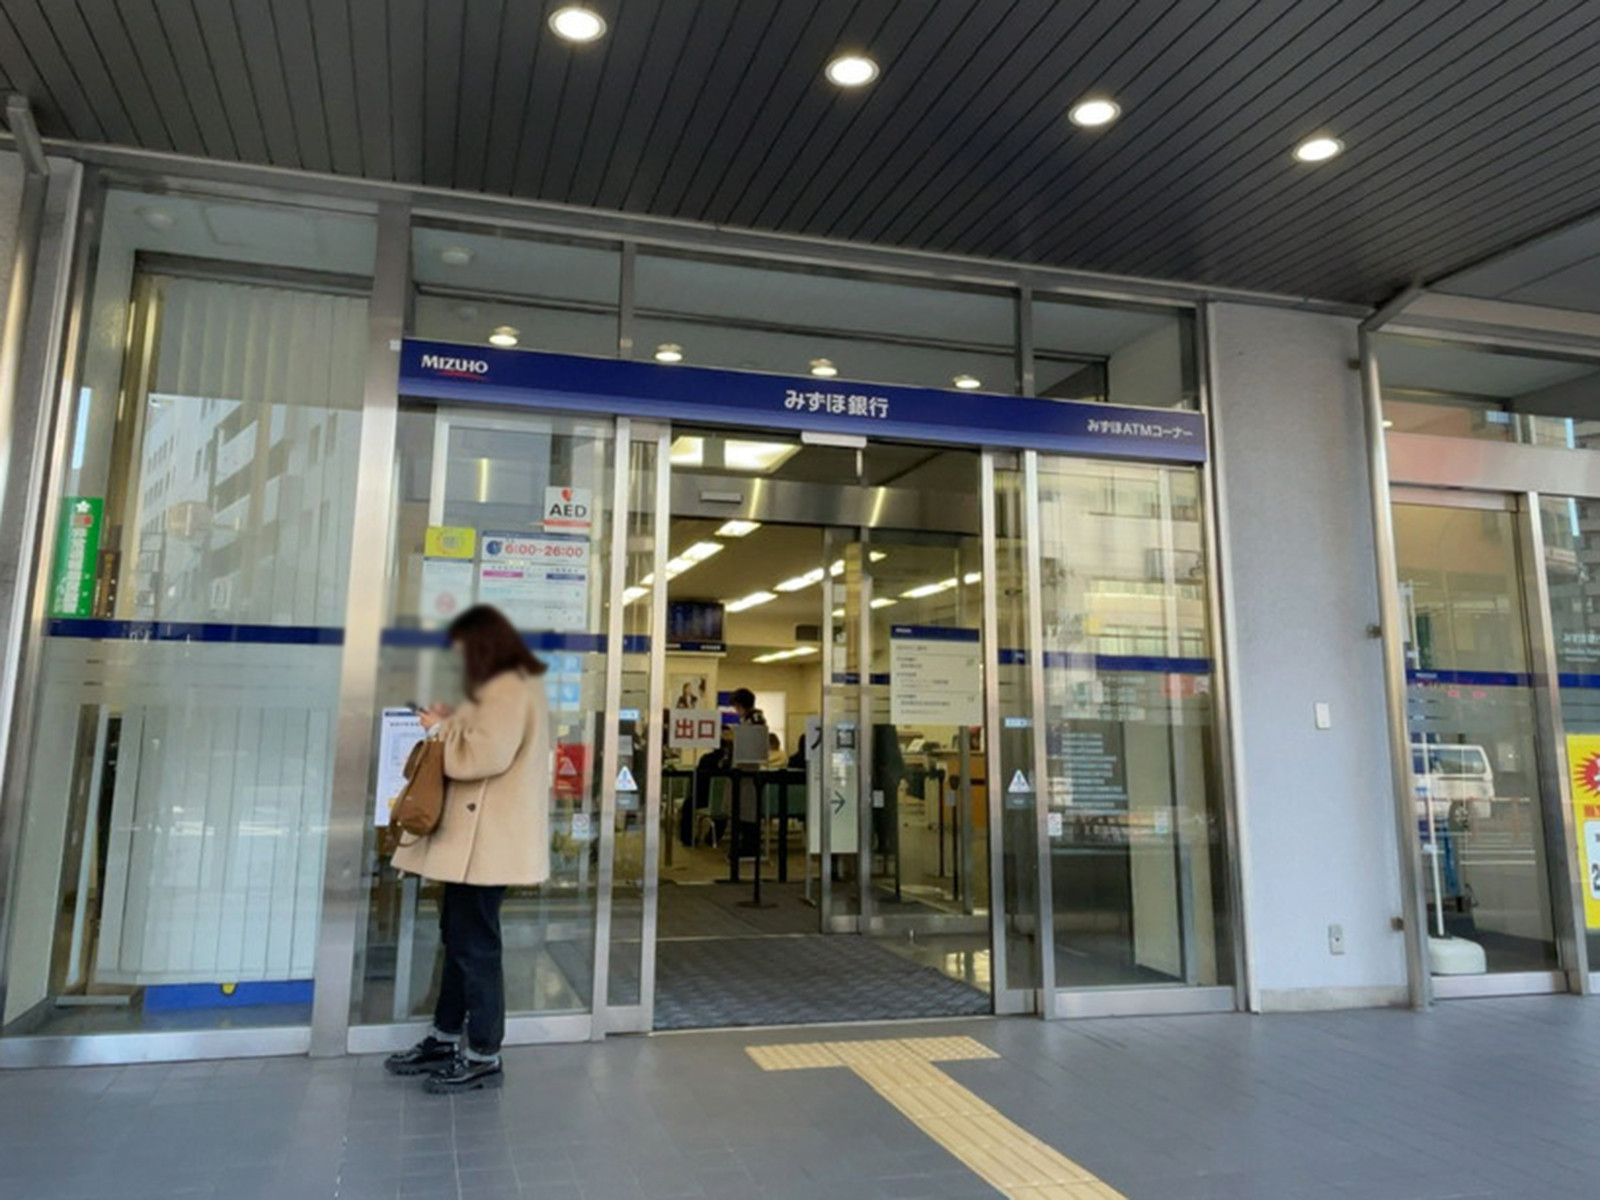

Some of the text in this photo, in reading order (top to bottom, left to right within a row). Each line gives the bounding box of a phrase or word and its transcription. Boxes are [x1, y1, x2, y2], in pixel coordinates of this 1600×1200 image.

[421, 355, 489, 373] MIZUHO
[784, 389, 889, 418] みずほ銀行
[1087, 419, 1193, 438] みずほATMコーナー
[549, 503, 588, 518] AED
[675, 718, 716, 739] 出口
